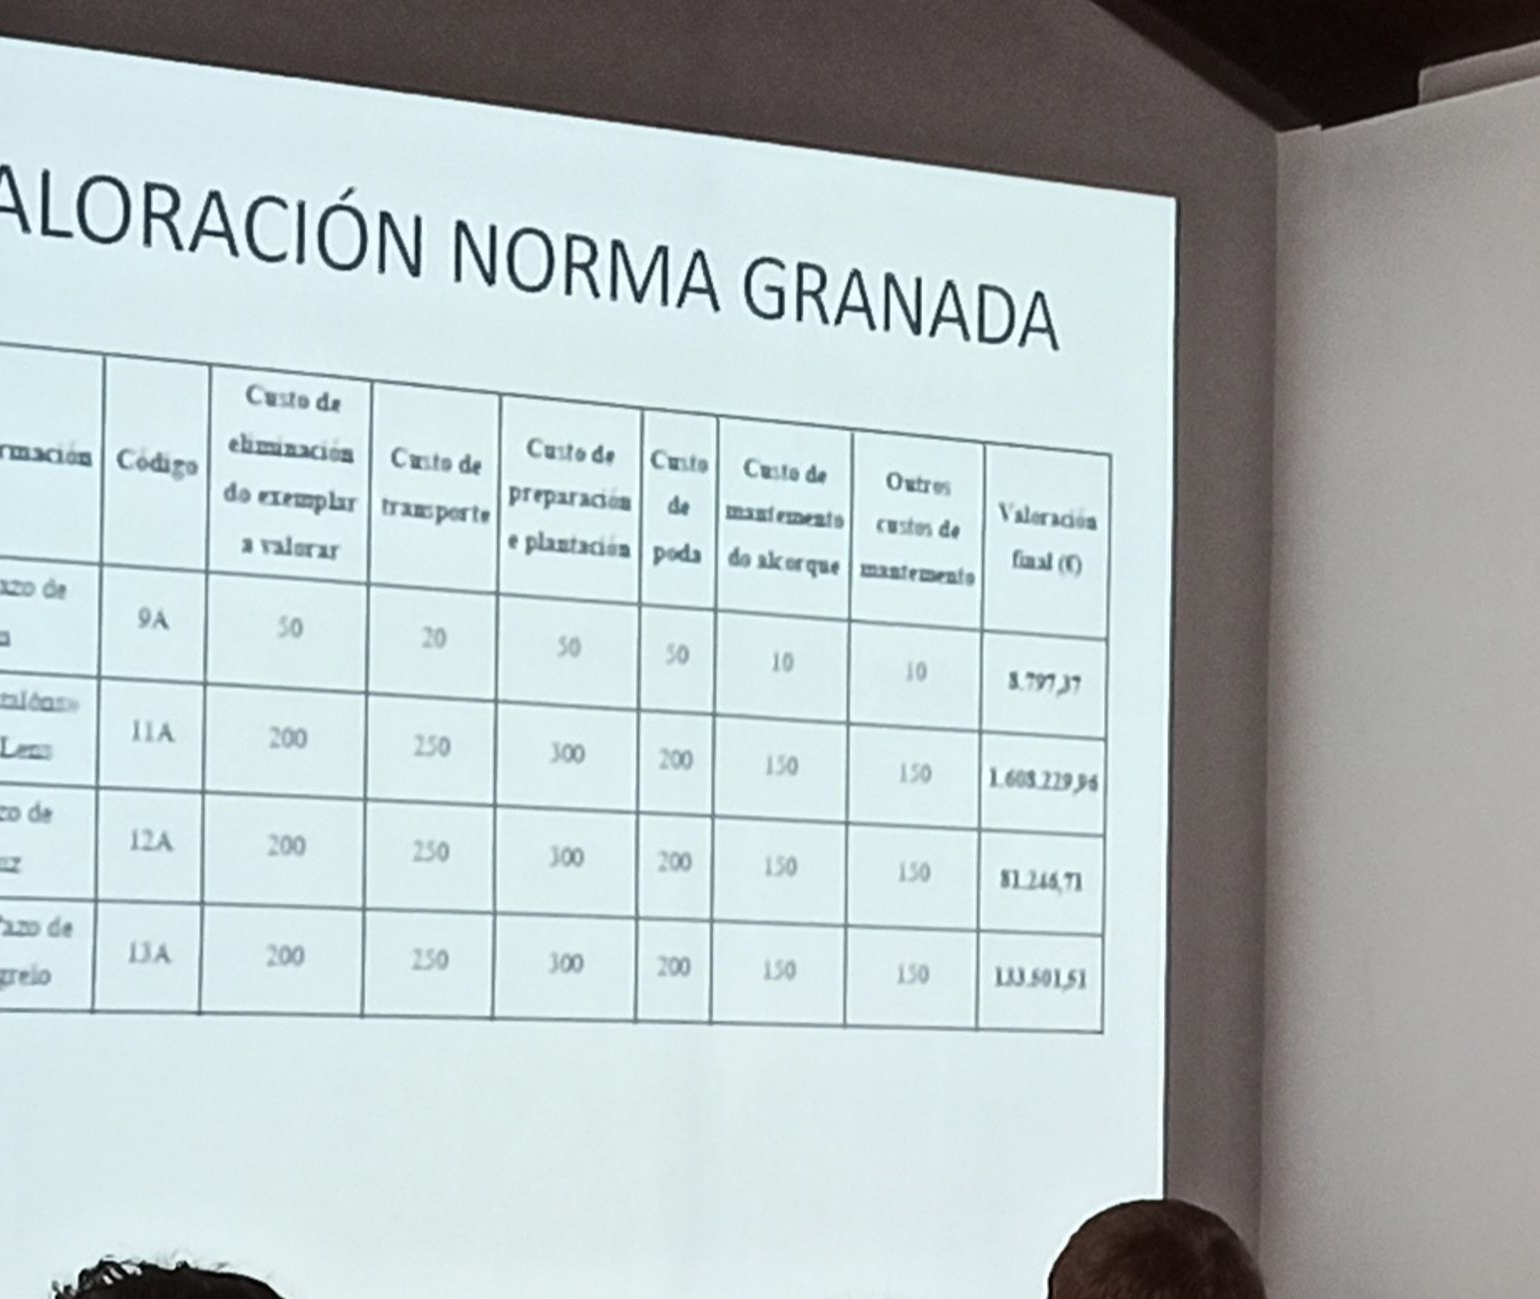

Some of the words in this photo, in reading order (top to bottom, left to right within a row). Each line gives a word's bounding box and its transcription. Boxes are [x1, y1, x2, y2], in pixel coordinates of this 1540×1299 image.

[452, 217, 722, 313] NORMA
[742, 255, 1063, 351] GRANADA
[245, 383, 309, 409] Custo
[316, 391, 342, 413] de
[390, 446, 452, 472] Custo
[457, 453, 482, 476] de
[526, 437, 586, 463] Custo
[591, 443, 615, 466] de
[650, 450, 708, 475] Custo
[743, 458, 801, 482] Custo
[803, 463, 827, 485] de
[886, 472, 951, 496] Outros
[223, 483, 250, 505] do
[257, 487, 358, 516] exemplar
[668, 497, 691, 517] de
[380, 497, 490, 525] transporte
[876, 516, 932, 539] custos
[938, 519, 961, 540] de
[241, 538, 254, 554] a
[260, 535, 341, 560] valorar
[653, 543, 702, 566] poda
[728, 548, 752, 570] do
[757, 550, 841, 577] alcorque
[1012, 551, 1053, 572] final
[43, 578, 67, 599] de
[138, 607, 170, 630] 9A
[278, 617, 303, 638] 50
[422, 628, 447, 648] 20
[558, 636, 581, 657] 50
[665, 643, 689, 664] 50
[772, 652, 793, 671] 10
[906, 661, 927, 682] 10
[132, 719, 175, 743] 11A
[269, 727, 308, 750] 200
[414, 735, 451, 757] 250
[550, 743, 585, 765] 300
[659, 748, 693, 770] 200
[765, 755, 799, 776] 150
[899, 763, 932, 784] 150
[27, 801, 53, 824] de
[129, 828, 174, 854] 12A
[267, 834, 305, 857] 200
[412, 840, 450, 863] 250
[549, 847, 585, 868] 300
[657, 850, 692, 872] 200
[764, 856, 798, 877] 150
[897, 862, 931, 883] 150
[47, 916, 73, 938] de
[266, 945, 305, 967] 200
[411, 948, 449, 971] 250
[549, 953, 584, 973] 300
[657, 956, 691, 977] 200
[763, 960, 796, 980] 150
[897, 964, 930, 985] 150
